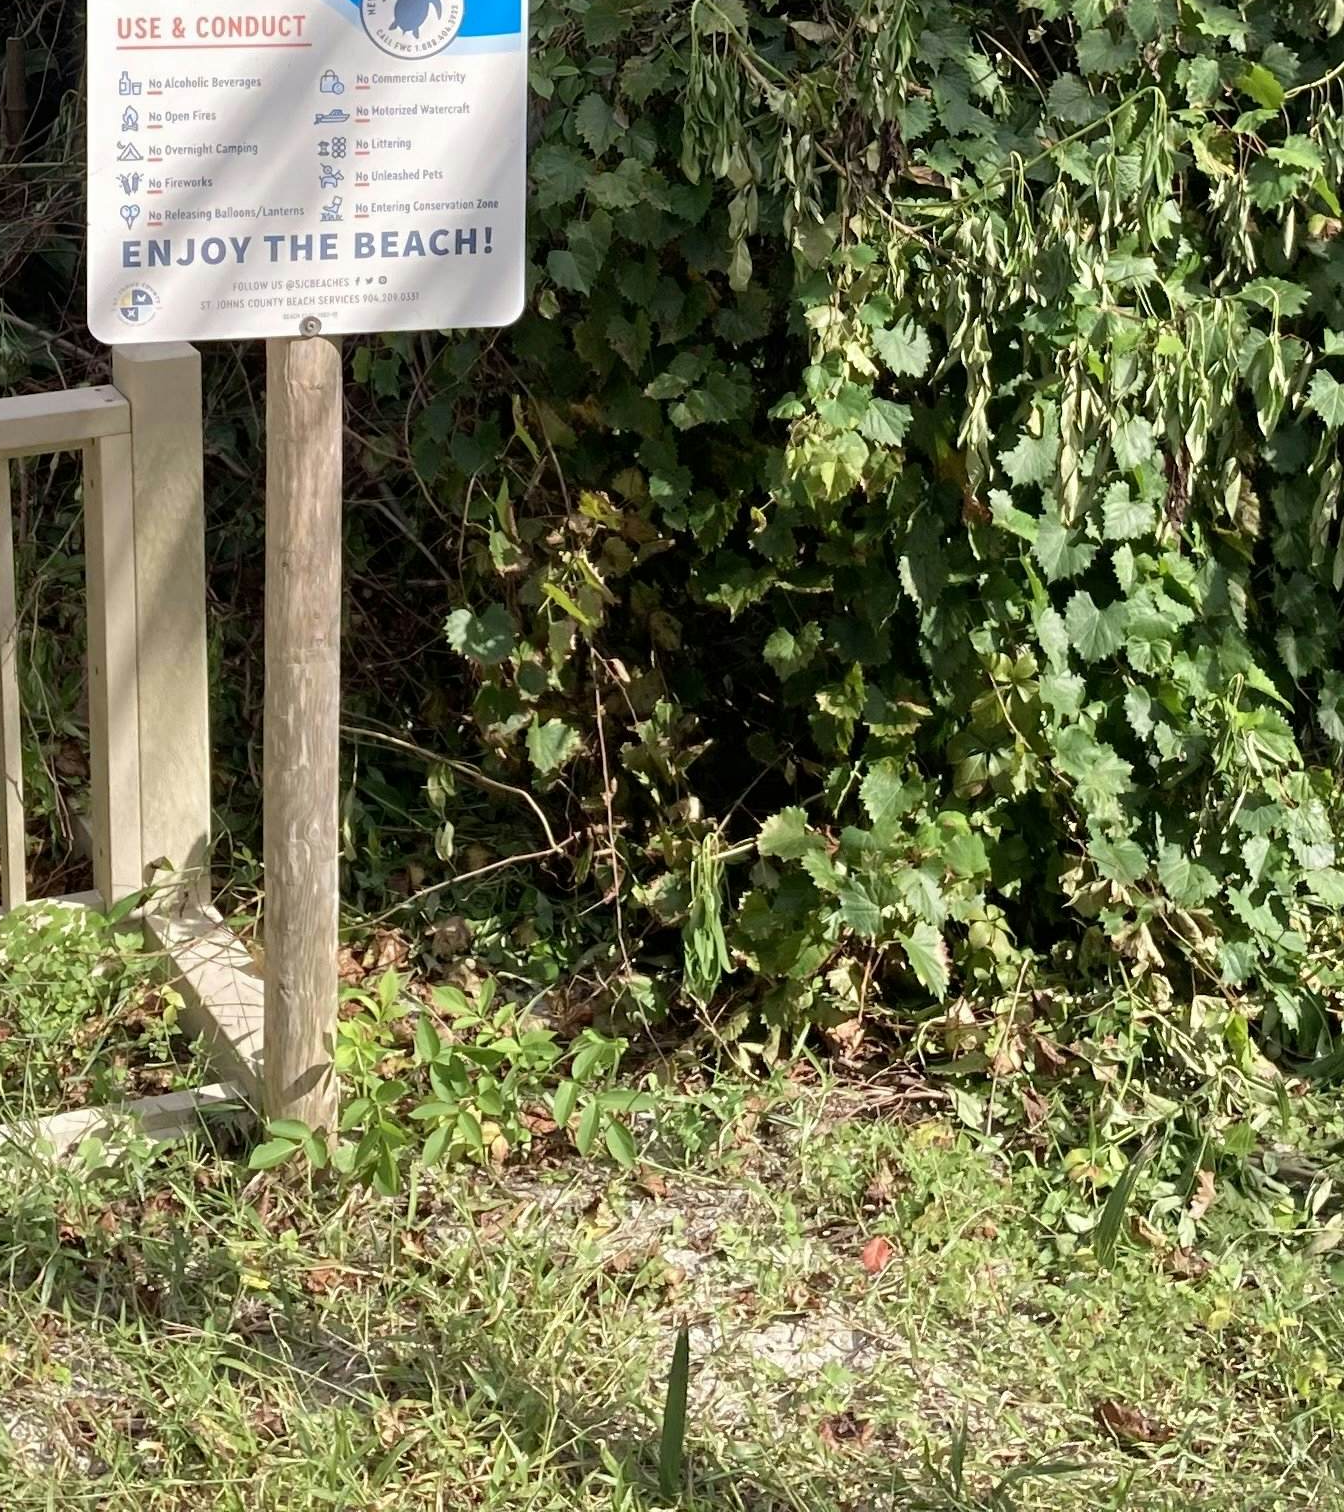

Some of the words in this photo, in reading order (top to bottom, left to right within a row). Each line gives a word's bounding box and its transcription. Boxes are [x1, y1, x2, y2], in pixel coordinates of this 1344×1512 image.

[117, 16, 161, 40] USE
[171, 16, 186, 38] &
[196, 14, 306, 38] CONDUCT
[376, 28, 395, 47] CALL
[148, 78, 162, 90] No
[164, 77, 209, 88] Alcoholic
[211, 77, 262, 89] Beverages
[354, 73, 370, 84] No
[371, 71, 427, 84] Commercial
[428, 71, 466, 84] Activity
[355, 105, 369, 116] No
[371, 103, 418, 116] Motorized
[419, 102, 470, 115] Watercraft
[148, 111, 162, 122] No
[164, 110, 190, 124] Open
[192, 110, 216, 120] Fires
[148, 144, 162, 156] No
[164, 143, 213, 157] Overnight
[215, 142, 258, 155] Camping
[355, 138, 369, 149] No
[371, 137, 411, 150] Littering
[355, 171, 369, 182] No
[371, 168, 420, 181] Unleashed
[422, 169, 443, 180] Pets
[148, 177, 162, 189] No
[164, 176, 213, 188] Fireworks
[354, 202, 369, 214] No
[370, 200, 410, 214] Entering
[412, 200, 474, 211] Conservation
[476, 198, 499, 209] Zone
[147, 210, 162, 221] No
[164, 207, 212, 221] Releasing
[214, 206, 304, 219] Balloons/Lanterns
[122, 235, 252, 268] ENJOY
[263, 232, 338, 262] THE
[354, 226, 492, 259] BEACH!
